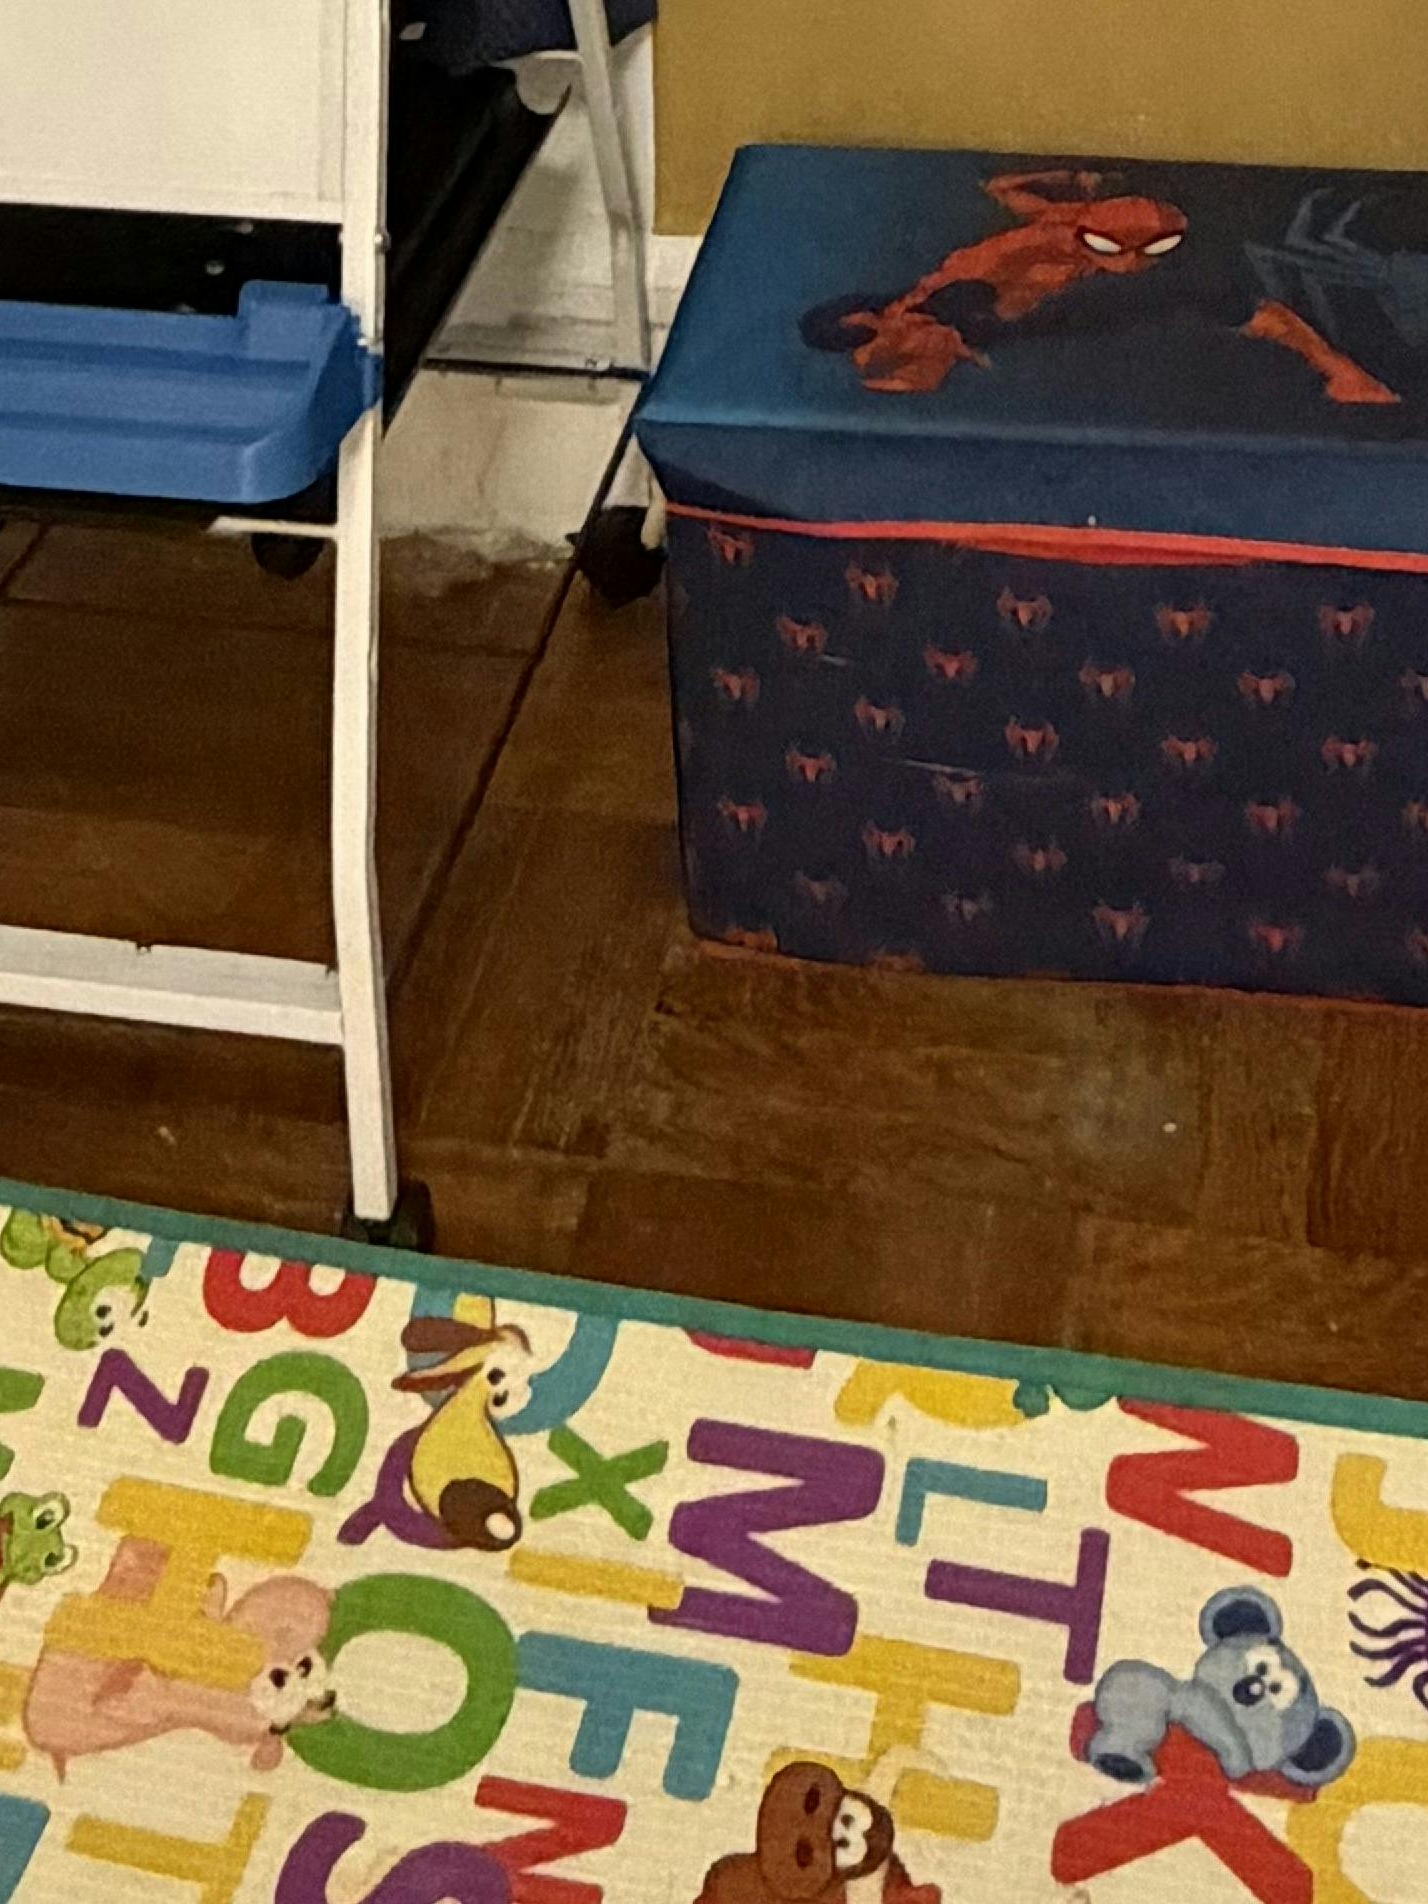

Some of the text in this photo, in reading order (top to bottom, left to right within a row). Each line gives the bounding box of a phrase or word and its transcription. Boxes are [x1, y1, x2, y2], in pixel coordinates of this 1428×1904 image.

[210, 1350, 370, 1497] G
[529, 1422, 670, 1541] X
[895, 1457, 1048, 1546] L
[284, 1572, 519, 1794] O
[924, 1527, 1111, 1686] T
[516, 1629, 741, 1802] F
